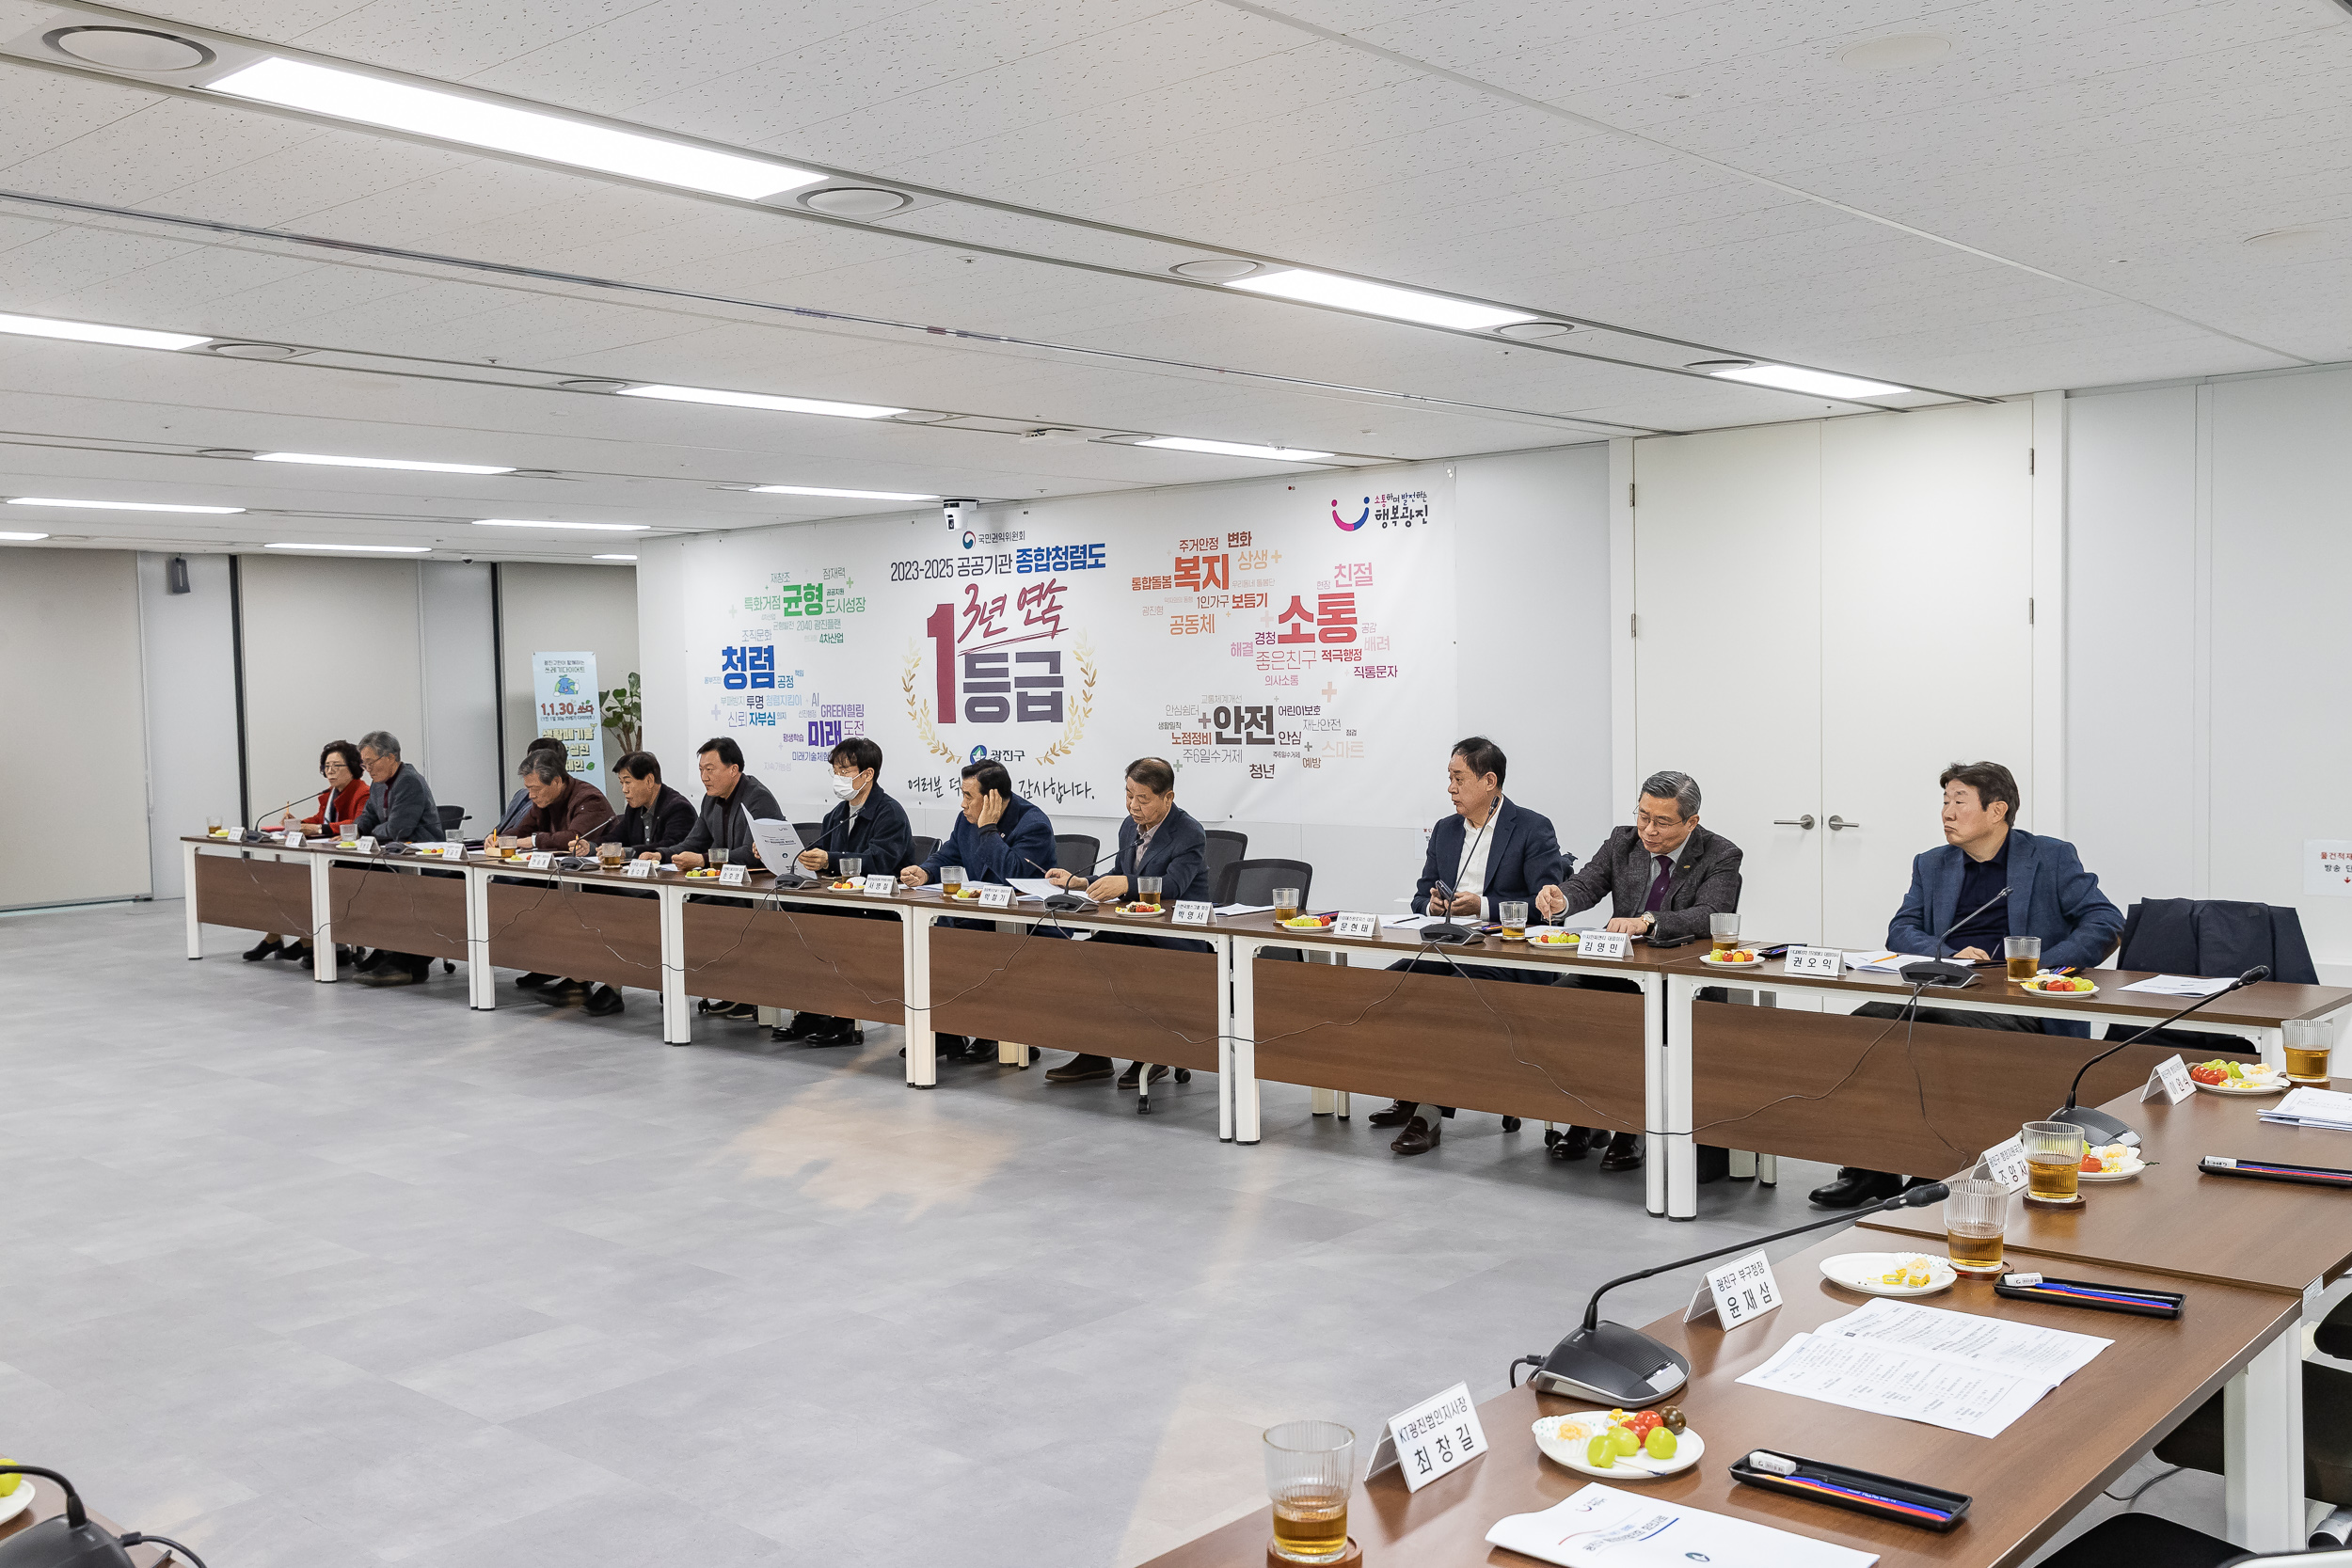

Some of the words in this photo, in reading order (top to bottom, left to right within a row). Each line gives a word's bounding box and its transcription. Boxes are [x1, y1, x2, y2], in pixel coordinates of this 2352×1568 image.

[1374, 493, 1400, 508] 소통하며
[1401, 491, 1428, 506] 발전하는
[1375, 504, 1428, 529] 행복광진
[978, 531, 1025, 544] 국민권익위원회
[1179, 536, 1219, 553] 주거안정
[1227, 531, 1252, 548] 변화
[890, 557, 954, 581] 2023-2025
[958, 553, 1012, 578] 공공기관
[1016, 543, 1106, 574] 종합청렴도
[1237, 549, 1268, 571] 상생
[771, 572, 790, 583] 재창조
[822, 566, 846, 580] 잠재력
[1174, 553, 1230, 593] 복지
[1334, 562, 1374, 589] 친절
[1131, 576, 1172, 591] 통합돌봄
[744, 595, 781, 612] 특화거점
[783, 582, 823, 617] 균형
[826, 596, 866, 614] 도시성장
[1197, 594, 1230, 610] 1인가구
[1232, 593, 1268, 610] 보듬기
[957, 583, 1009, 643] 3년
[1016, 578, 1068, 640] 연속
[1142, 606, 1164, 617] 광진형
[796, 620, 813, 631] 2040
[814, 619, 841, 630] 광진플랜
[1170, 613, 1216, 636] 공동체
[1278, 593, 1359, 644] 소통
[741, 628, 771, 642] 조직문화
[1361, 623, 1377, 634] 공감
[818, 632, 844, 644] 4차산업
[1255, 631, 1276, 645] 경청
[1364, 636, 1391, 652] 배려
[1231, 641, 1254, 657] 해결
[1321, 648, 1362, 662] 적극행정
[722, 645, 775, 689] 청렴
[1255, 649, 1317, 671] 좋은친구
[1353, 665, 1398, 679] 직통문자
[777, 675, 794, 689] 공정
[1264, 674, 1299, 687] 의사소통
[746, 695, 764, 709] 투명
[766, 694, 802, 706] 청렴지킴이
[811, 692, 819, 707] AI
[820, 704, 865, 719] GREEN힐링
[1165, 704, 1200, 717] 안심쉼터
[1278, 705, 1321, 717] 어린이보호
[728, 711, 747, 728] 신뢰
[749, 712, 776, 726] 자부심
[1214, 705, 1276, 745] 안전
[1302, 719, 1342, 732] 재난안전
[807, 721, 843, 747] 미래
[843, 721, 865, 736] 도전
[1171, 732, 1212, 746] 노점정비
[1278, 732, 1302, 745] 안심
[990, 750, 1025, 762] 광진구
[1183, 749, 1243, 764] 주6일수거제
[1321, 741, 1364, 758] 스마트
[1302, 757, 1321, 769] 예방
[1249, 764, 1276, 780] 청년
[908, 775, 944, 799] 여러분
[1018, 777, 1095, 803] 감사합니다.
[1716, 1274, 1737, 1292] 광진구
[1739, 1260, 1765, 1281] 부구청장
[1397, 1396, 1468, 1444] KT광진법인지사장
